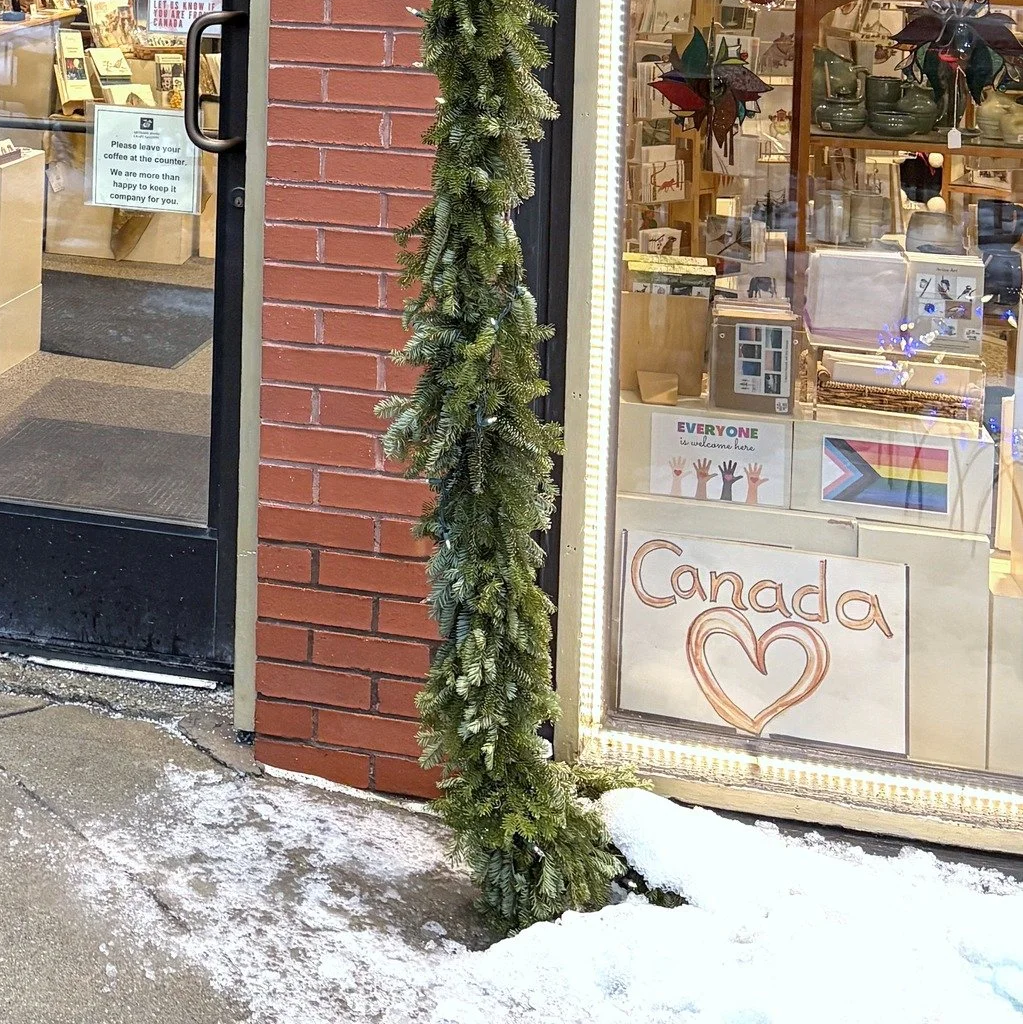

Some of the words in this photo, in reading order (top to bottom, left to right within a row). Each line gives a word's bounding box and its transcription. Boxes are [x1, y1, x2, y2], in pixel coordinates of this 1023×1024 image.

[154, 0, 167, 9] LET
[170, 1, 179, 10] US
[182, 1, 204, 10] KNOW
[208, 2, 216, 11] IF
[153, 9, 167, 18] YOU
[170, 9, 185, 19] ARE
[153, 18, 183, 28] CANADA
[111, 140, 137, 150] Please
[139, 142, 160, 152] leave
[161, 146, 181, 154] your
[103, 152, 128, 161] coffee
[130, 154, 137, 162] at
[139, 154, 152, 163] the
[154, 156, 187, 166] counter.
[110, 168, 123, 176] We
[124, 170, 137, 178] are
[139, 171, 160, 180] more
[161, 172, 180, 181] than
[112, 180, 137, 191] happy
[139, 182, 147, 190] to
[149, 183, 169, 193] keep
[170, 185, 177, 193] it
[109, 192, 146, 203] company
[147, 194, 159, 203] for
[161, 197, 179, 205] you.
[677, 421, 759, 439] EVERYONE
[680, 437, 689, 446] is
[690, 435, 733, 450] welcome
[734, 438, 756, 452] here
[631, 538, 894, 639] Canada
